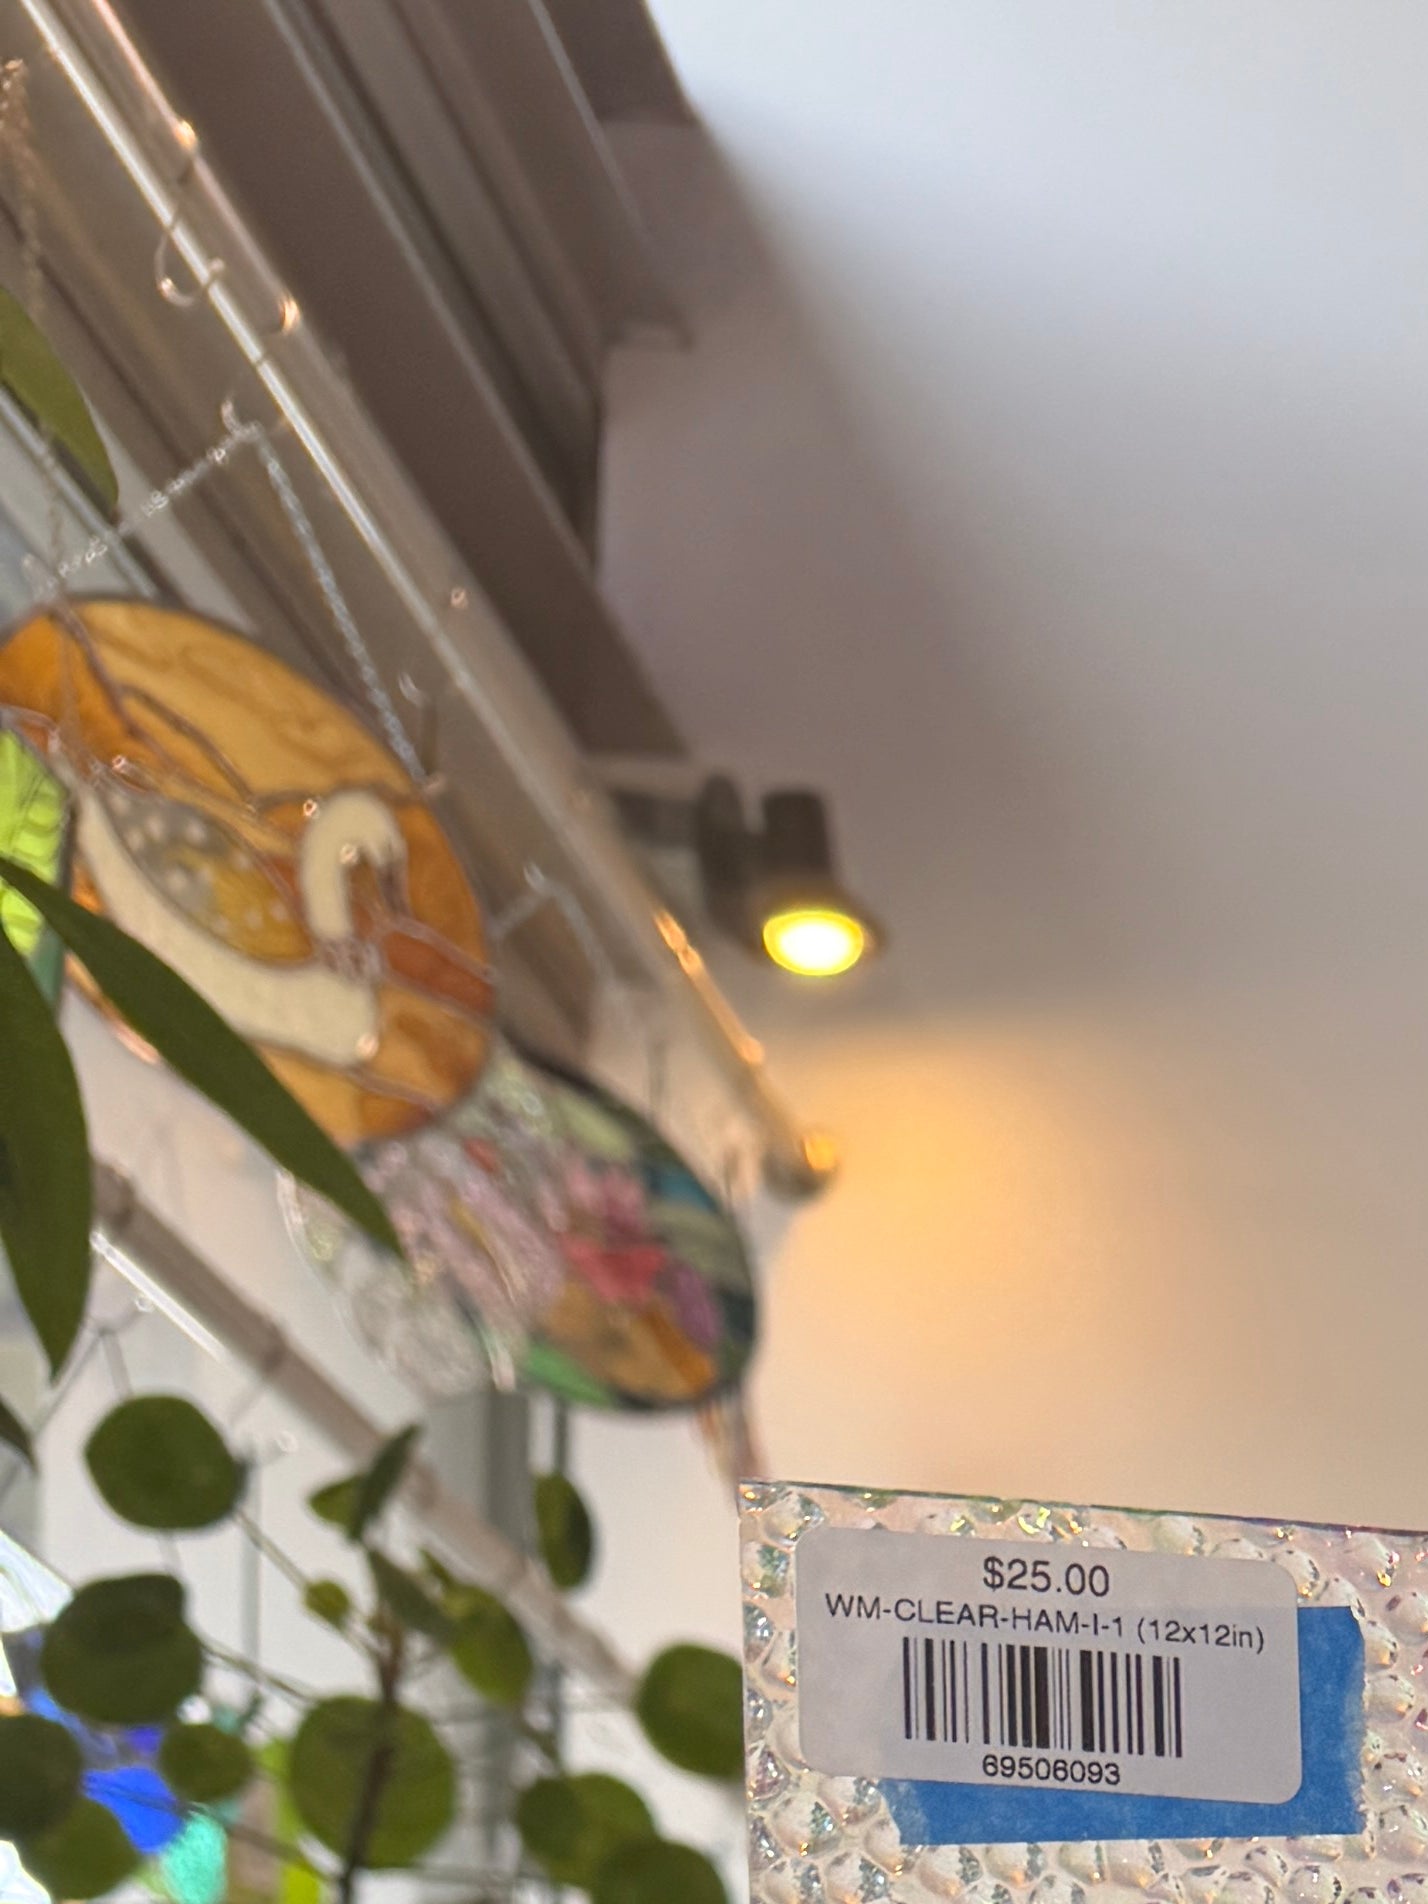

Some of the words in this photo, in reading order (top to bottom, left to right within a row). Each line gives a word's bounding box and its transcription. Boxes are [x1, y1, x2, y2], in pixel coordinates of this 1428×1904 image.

[982, 1557, 1110, 1597] $25.00
[824, 1592, 1124, 1637] WM-CLEAR-HAM-I-1
[1136, 1615, 1266, 1655] (12x12in)
[982, 1754, 1121, 1786] 69506093
